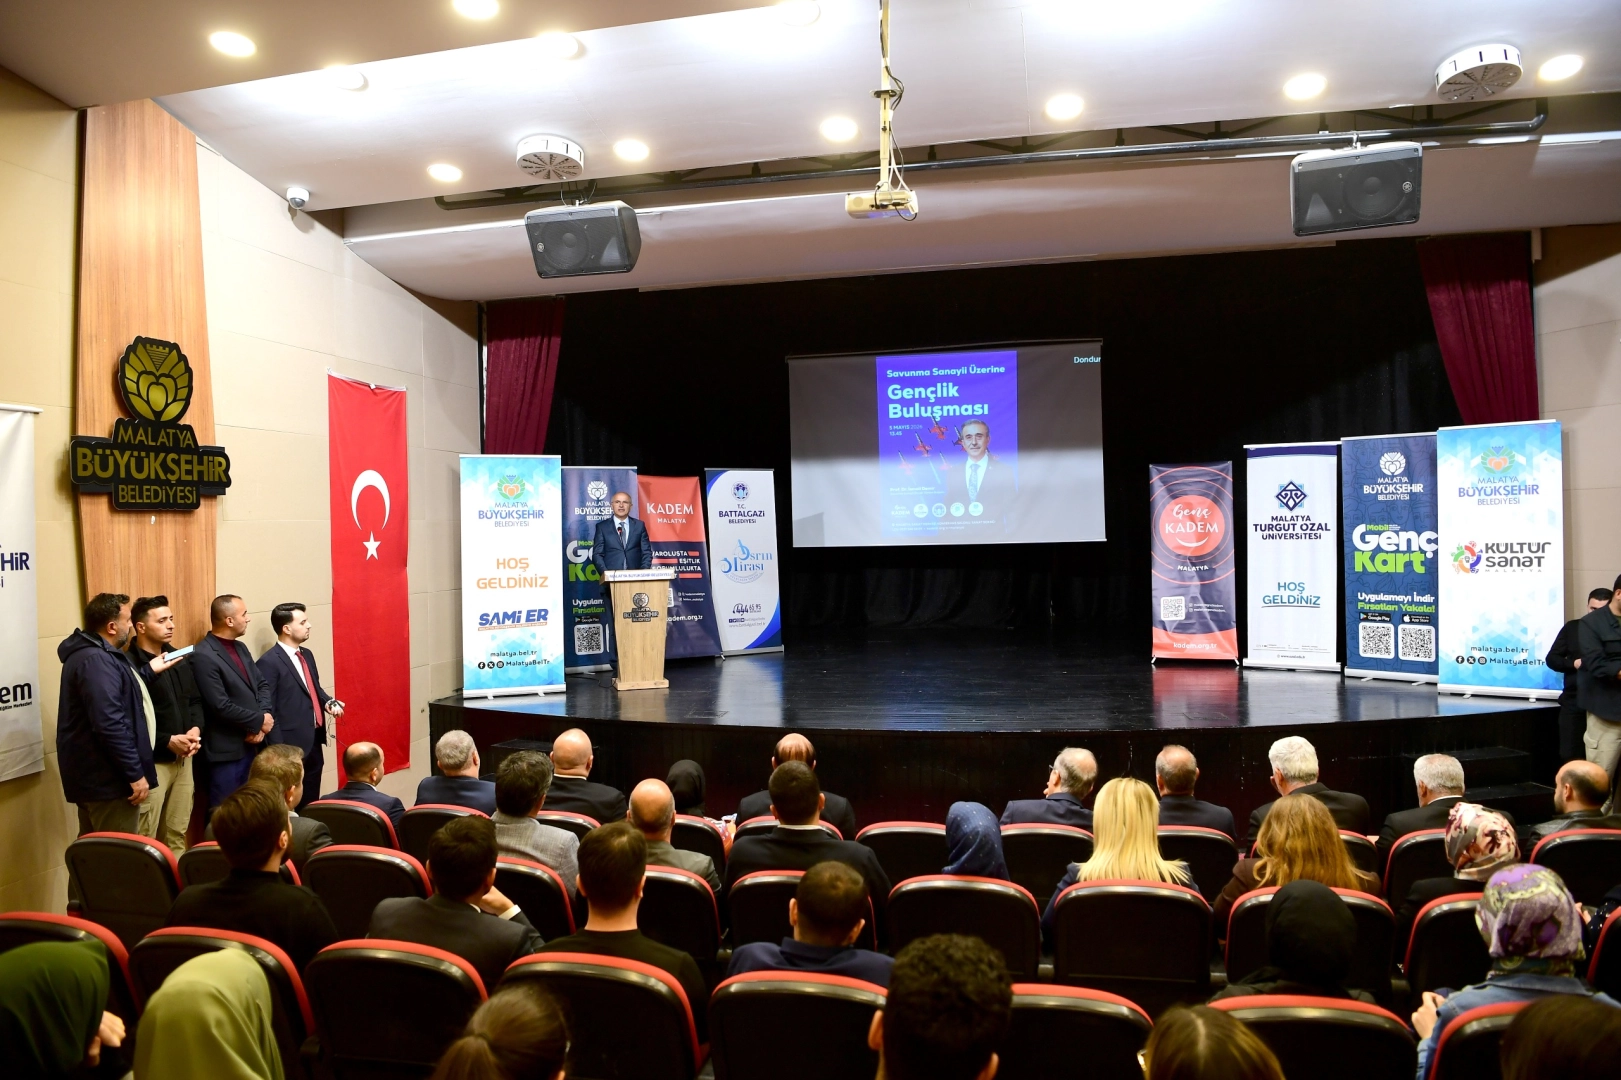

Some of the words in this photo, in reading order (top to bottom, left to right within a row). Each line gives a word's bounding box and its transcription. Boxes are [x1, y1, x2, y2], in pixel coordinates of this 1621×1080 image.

[886, 369, 930, 378] Savunma
[932, 366, 967, 376] Sanayii
[969, 364, 1005, 374] Üzerine
[888, 382, 960, 402] Gençlik
[888, 403, 989, 422] Buluşması
[118, 424, 195, 449] MALATYA
[1478, 476, 1519, 484] MALATYA
[646, 502, 694, 515] KADEM
[1172, 504, 1212, 519] Genç
[1165, 522, 1219, 534] KADEM
[1253, 523, 1297, 532] TURGUT
[1300, 522, 1330, 532] ÖZAL
[1352, 524, 1438, 559] Genç
[496, 558, 530, 572] HOŞ
[1354, 551, 1425, 573] Kart
[568, 564, 601, 582] Ka
[476, 574, 548, 590] GELDİNİZ
[1278, 582, 1306, 594] HOŞ
[1358, 592, 1411, 604] Uygulamayı
[1414, 592, 1435, 602] İndir
[525, 608, 549, 622] ER
[1400, 604, 1435, 613] Yakala!
[506, 658, 550, 667] MalatyaBelTr
[1490, 658, 1546, 666] MalatyaBelTr
